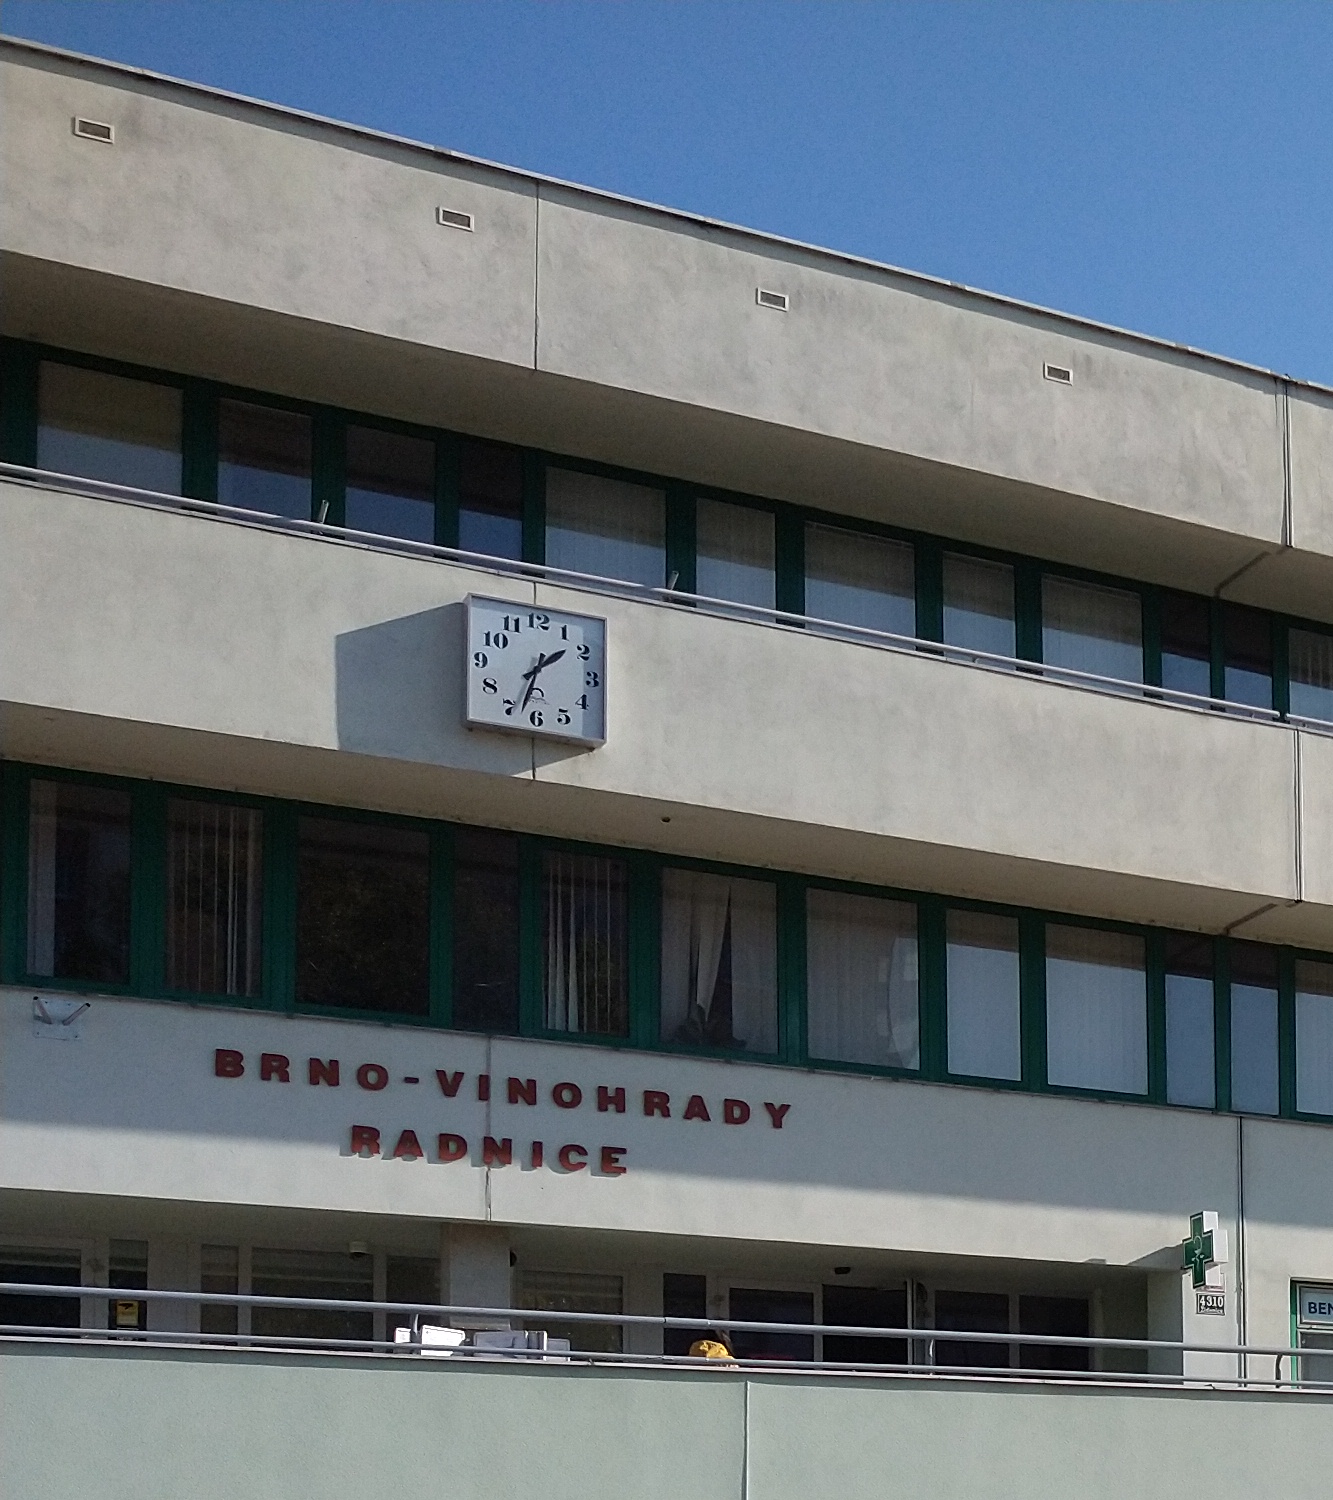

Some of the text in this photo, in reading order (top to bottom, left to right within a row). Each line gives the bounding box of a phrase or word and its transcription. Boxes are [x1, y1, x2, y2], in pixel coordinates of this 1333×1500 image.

[503, 615, 521, 634] 11
[527, 612, 550, 631] 12
[483, 630, 509, 649] 10
[560, 625, 569, 641] 1
[474, 652, 488, 669] 9
[577, 644, 590, 661] 2
[482, 677, 498, 694] 8
[586, 671, 600, 688] 3
[502, 698, 516, 716] 7
[575, 694, 589, 711] 4
[529, 710, 544, 727] 6
[557, 708, 571, 725] 5
[214, 1048, 791, 1129] BRNO-VINOHRADY
[351, 1125, 627, 1175] RADNICE
[1199, 1295, 1224, 1308] 4310
